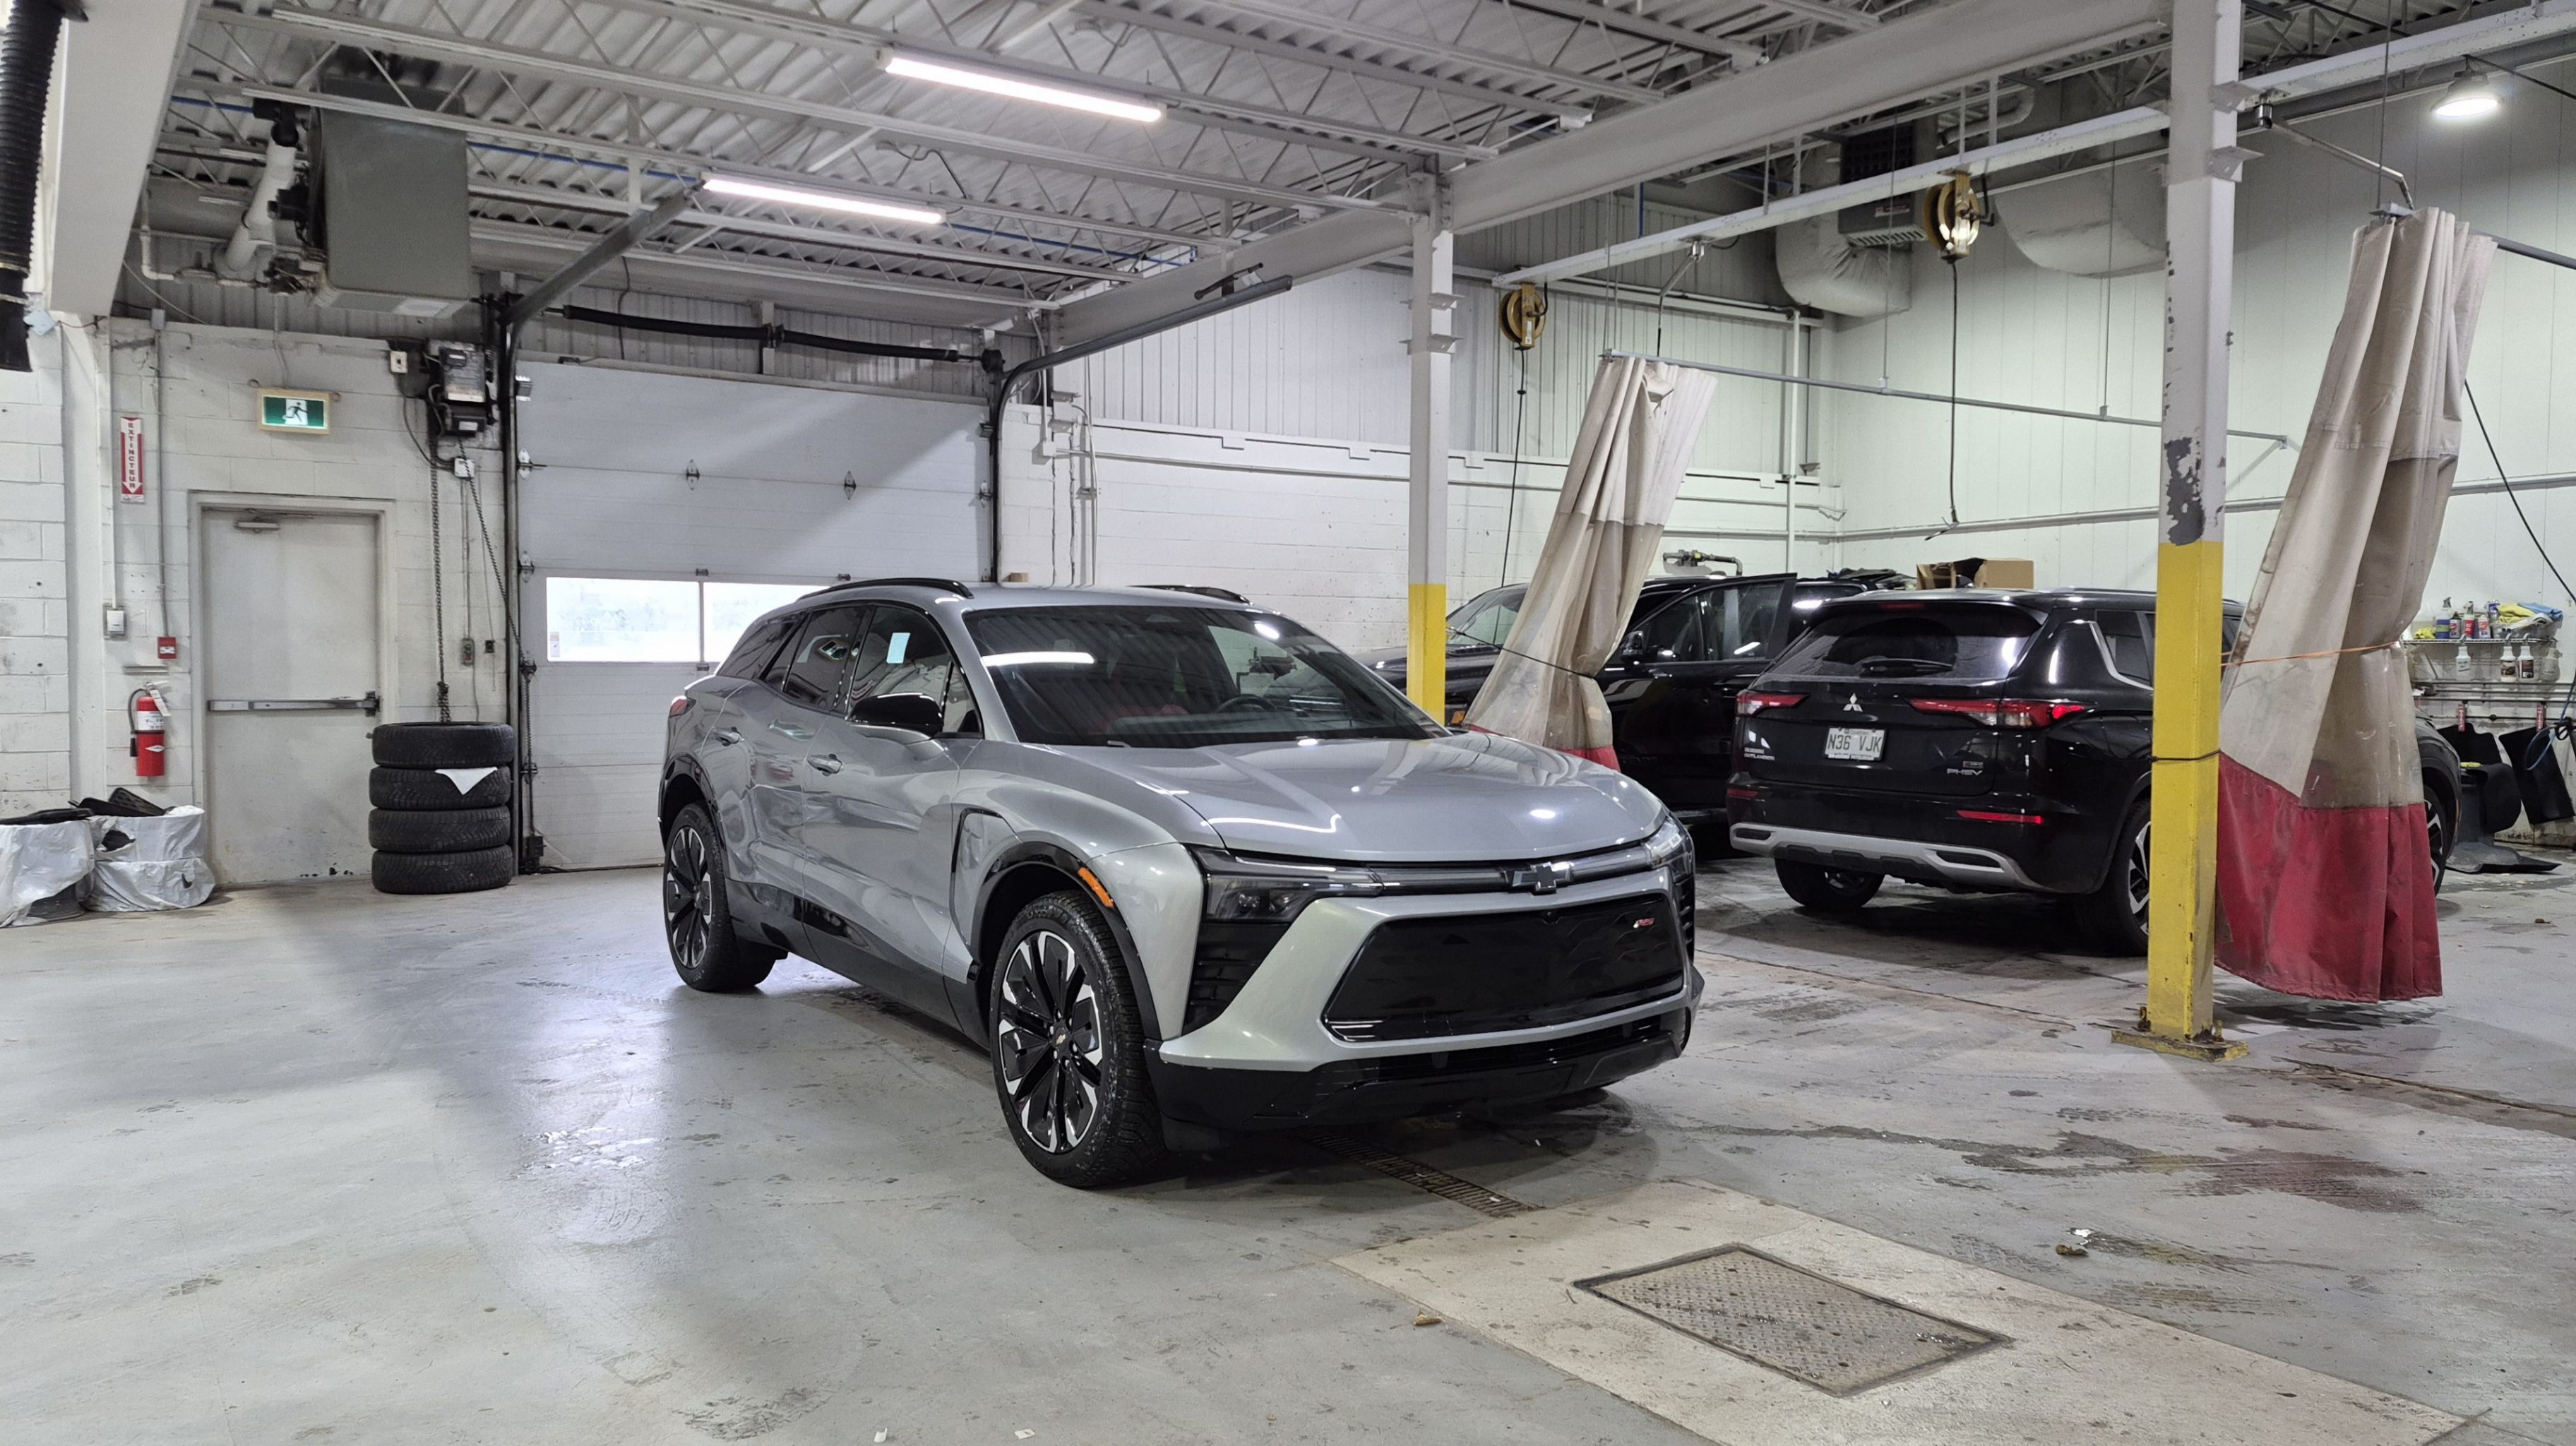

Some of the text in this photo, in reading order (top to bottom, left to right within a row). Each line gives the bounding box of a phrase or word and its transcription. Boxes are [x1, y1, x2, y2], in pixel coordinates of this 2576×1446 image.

[1827, 734, 1882, 753] N36 VJK
[1947, 767, 1983, 776] PHEV
